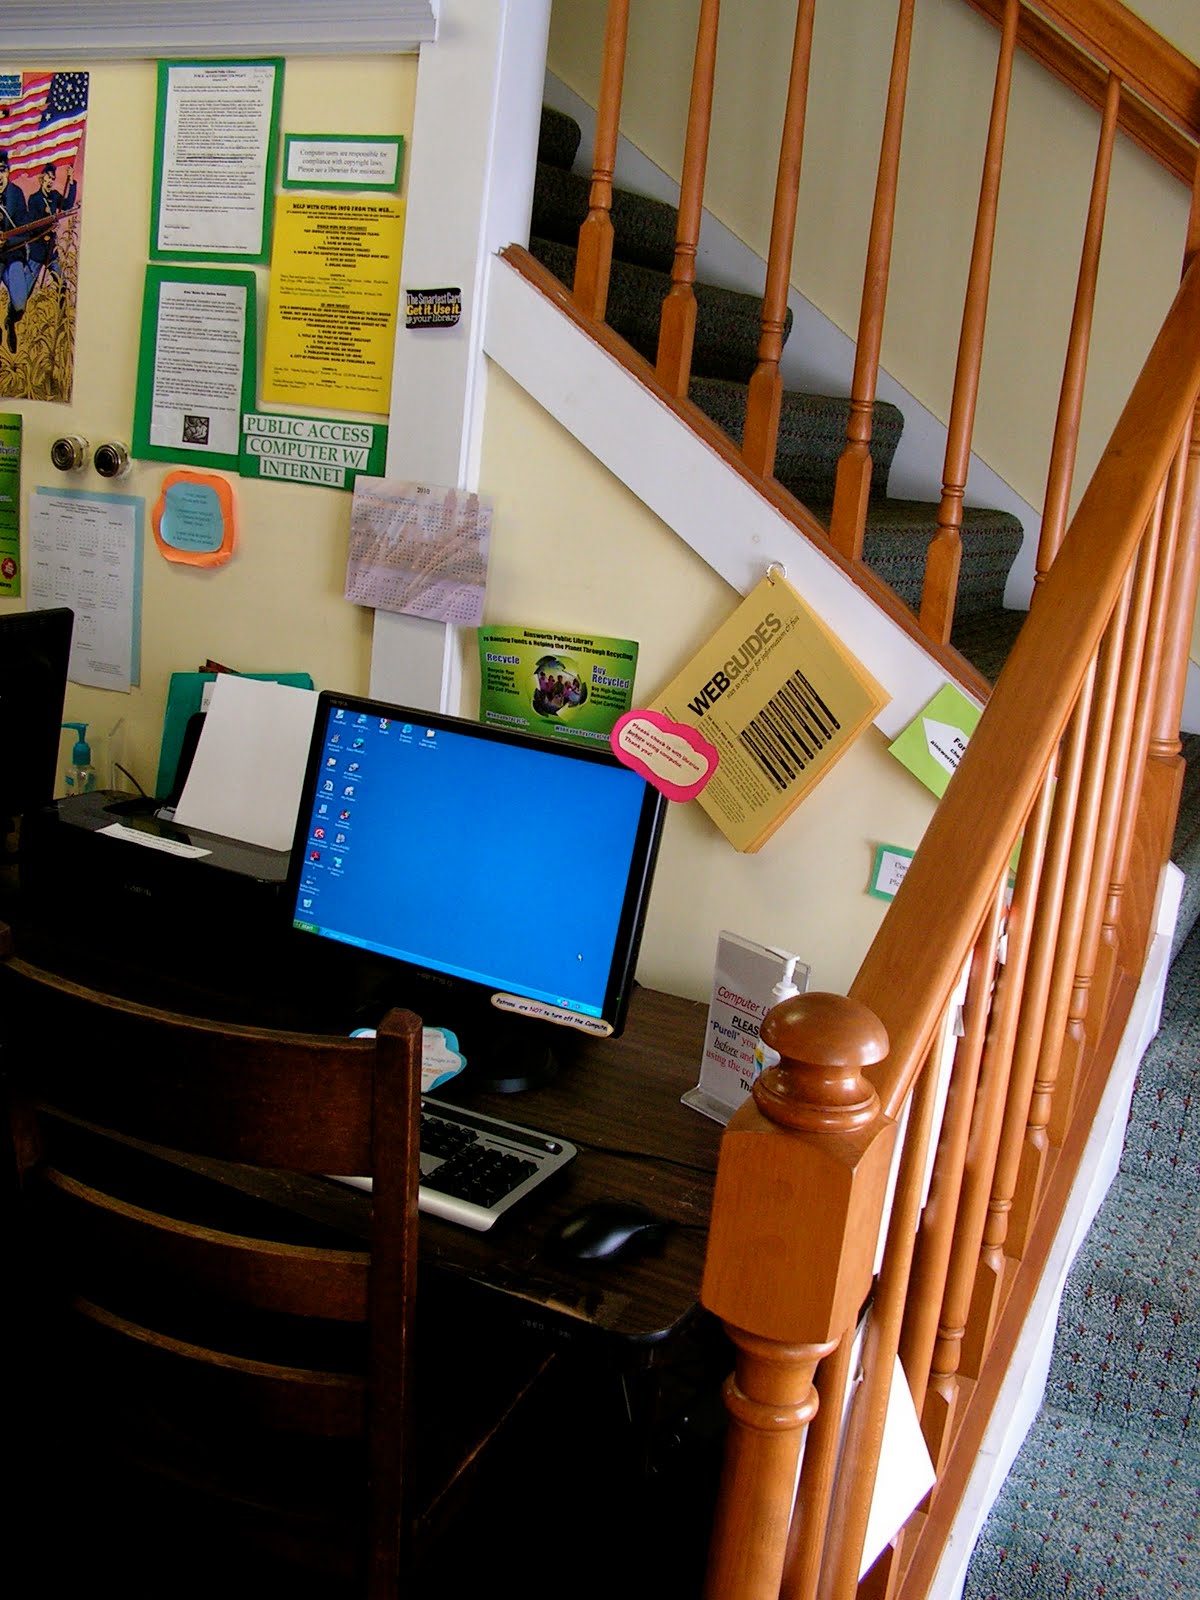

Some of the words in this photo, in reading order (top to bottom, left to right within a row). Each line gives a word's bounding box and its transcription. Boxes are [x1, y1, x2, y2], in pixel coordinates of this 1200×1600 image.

[408, 294, 418, 304] The
[418, 293, 446, 304] Smartest
[408, 304, 422, 315] Get
[433, 304, 450, 315] Use
[247, 417, 304, 436] PUBLIC
[307, 424, 369, 443] ACCESS
[250, 438, 338, 462] COMPUTER
[343, 448, 364, 467] W/
[263, 460, 342, 482] INTERNET
[417, 487, 430, 495] 2010
[524, 631, 553, 642] Ainsworth
[554, 634, 572, 643] Public
[573, 636, 594, 647] Library
[490, 637, 510, 645] Raising
[533, 640, 554, 649] Helping
[565, 644, 582, 652] Planet
[583, 647, 605, 657] Through
[607, 649, 633, 662] Recycling
[487, 653, 520, 665] Recycle
[687, 612, 782, 717] WEBGUIDES
[593, 665, 606, 675] Buy
[592, 674, 630, 688] Recycled
[624, 736, 641, 749] Thank
[496, 998, 515, 1008] Patrons
[529, 1006, 543, 1014] NOT
[718, 986, 760, 1012] Computer
[732, 1015, 759, 1036] PLEAS
[714, 1037, 739, 1056] before
[740, 1050, 754, 1064] and
[742, 1036, 756, 1049] you
[706, 1049, 726, 1068] using
[728, 1059, 741, 1072] the
